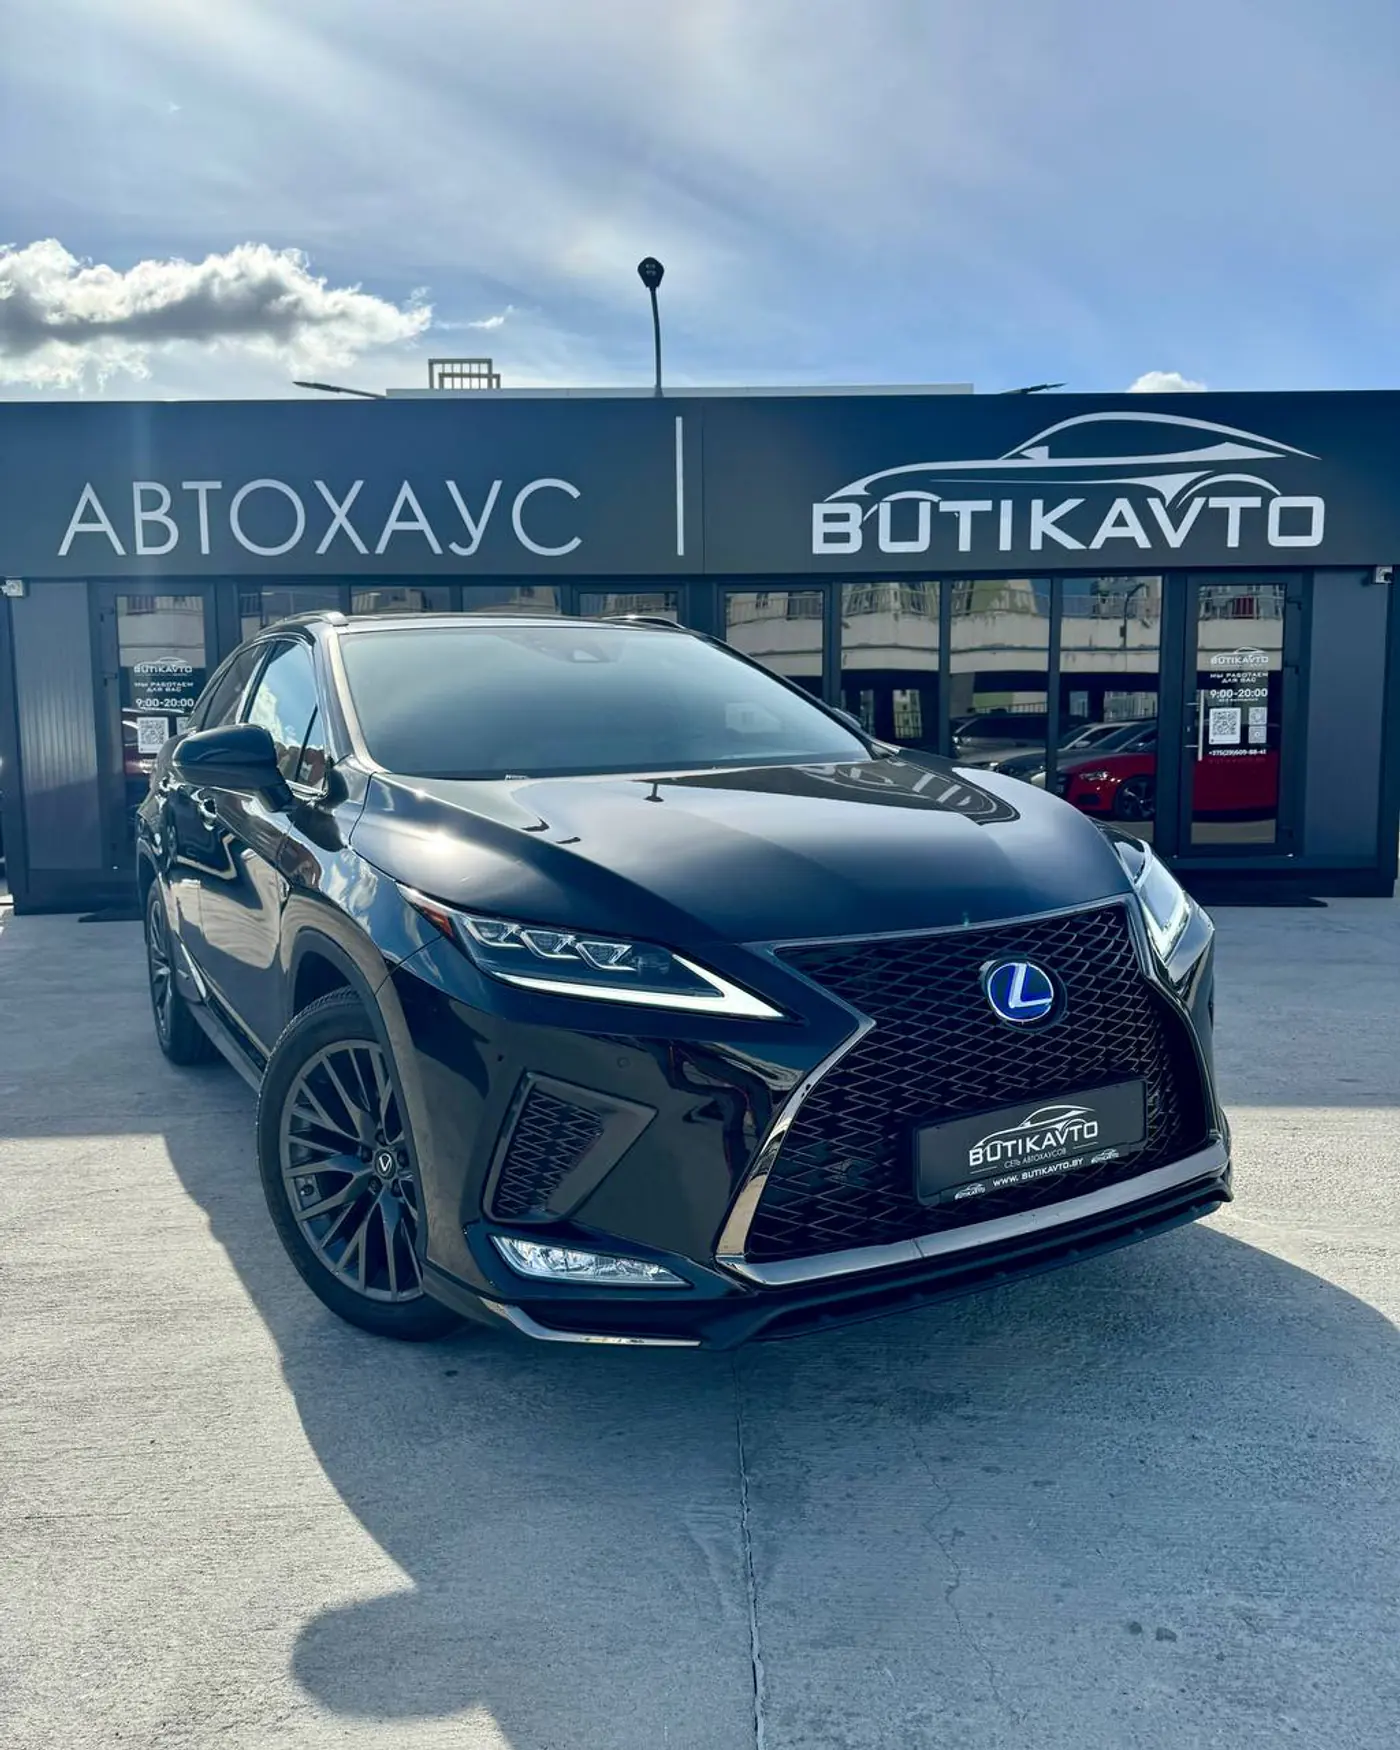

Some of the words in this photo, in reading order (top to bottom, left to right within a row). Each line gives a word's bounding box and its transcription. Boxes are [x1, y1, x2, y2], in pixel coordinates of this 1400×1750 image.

[57, 478, 582, 556] АВТОХАУС
[812, 496, 1325, 554] BUTIKAVTO
[136, 698, 194, 707] 9:00-20:00
[1210, 688, 1268, 699] 9:00-20:00
[969, 1121, 1098, 1167] BUTIKAVTO
